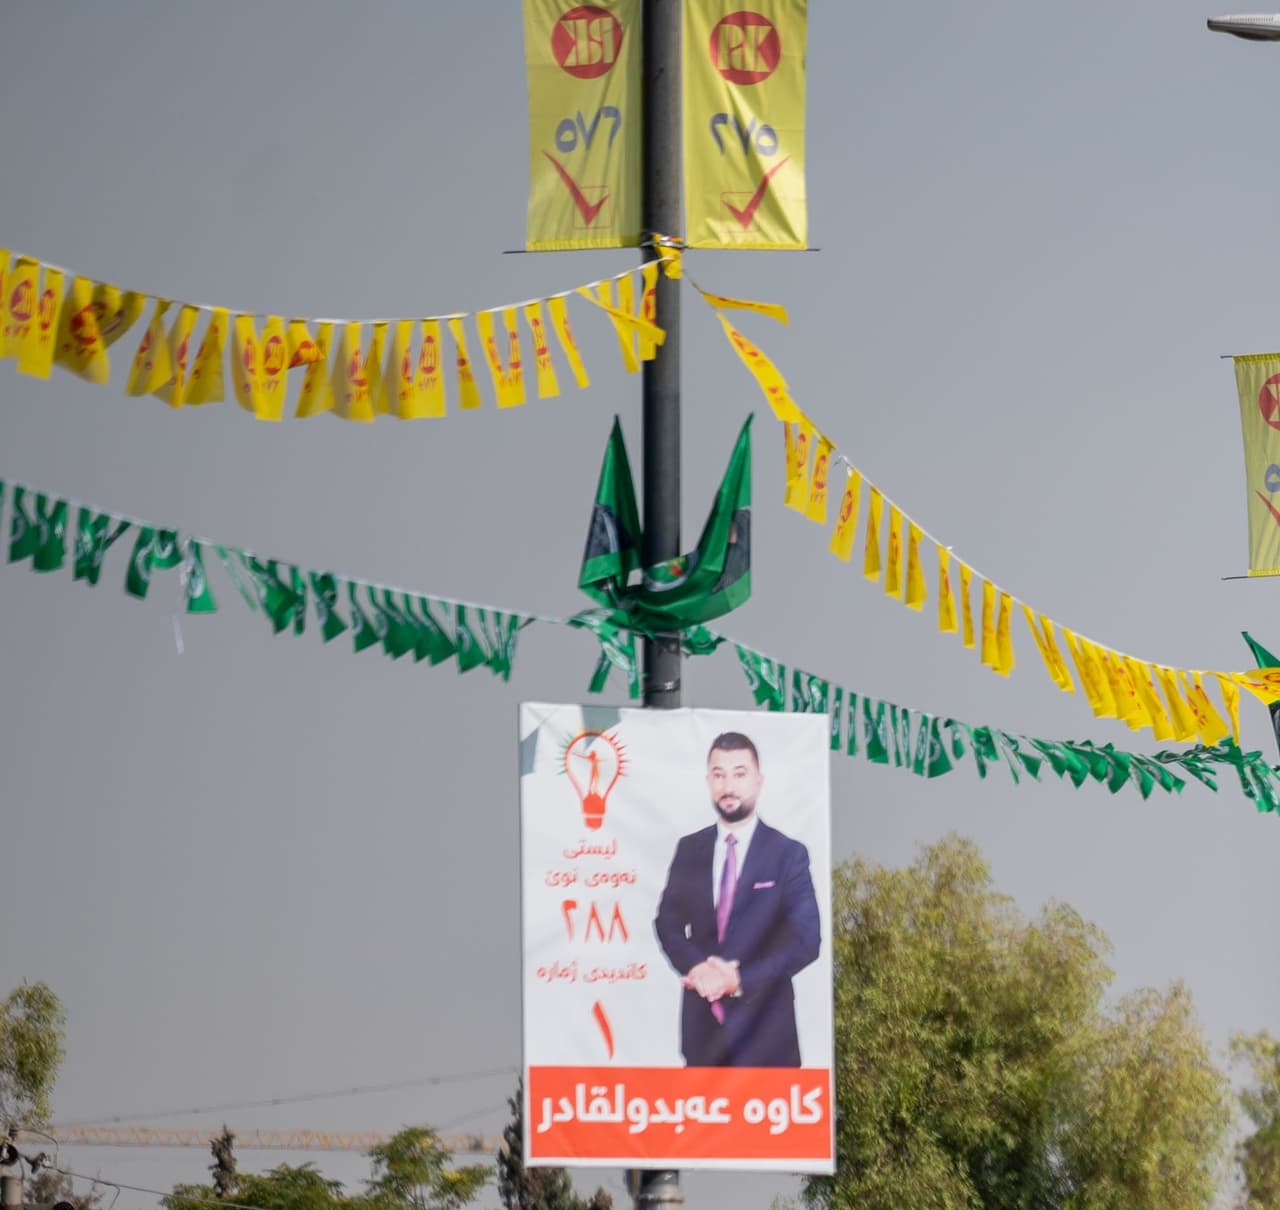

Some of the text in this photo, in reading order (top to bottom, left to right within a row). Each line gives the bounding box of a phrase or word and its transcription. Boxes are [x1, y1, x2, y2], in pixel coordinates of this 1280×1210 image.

[560, 898, 630, 944] ٢٨٨
[591, 1000, 615, 1060] ١
[536, 1082, 824, 1136] کاوە عەبدولقادر
